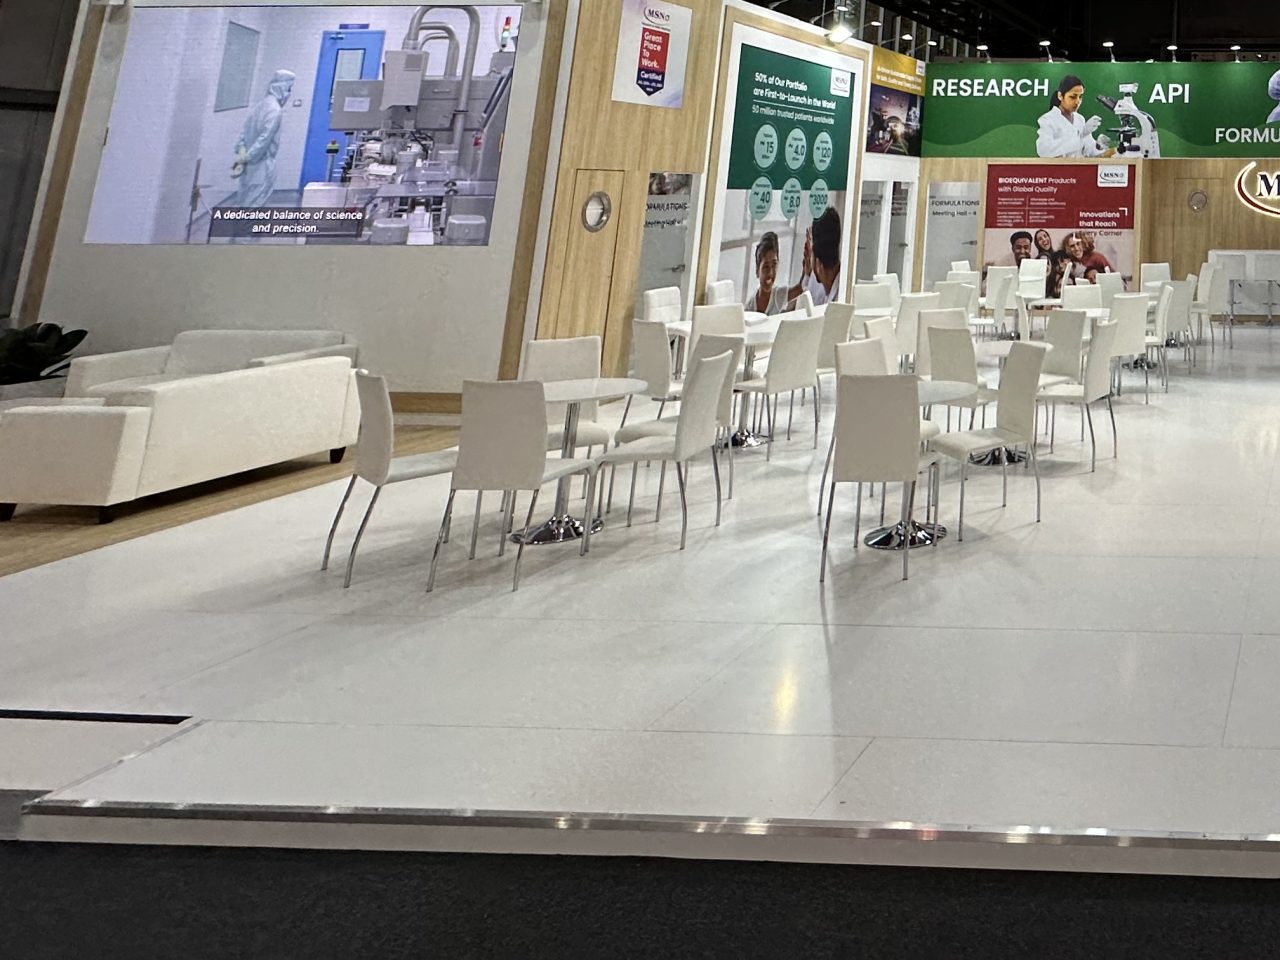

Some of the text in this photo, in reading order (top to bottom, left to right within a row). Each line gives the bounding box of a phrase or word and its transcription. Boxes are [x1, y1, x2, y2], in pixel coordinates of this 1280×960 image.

[648, 8, 666, 20] MSN
[644, 32, 663, 43] Great
[643, 41, 662, 52] Place
[642, 49, 650, 57] To
[775, 76, 786, 87] Our
[753, 87, 764, 97] are
[931, 78, 1050, 98] RESEARCH
[1148, 83, 1190, 105] API
[1034, 186, 1058, 194] Quality
[214, 210, 363, 221] A dedicated balance of science
[1079, 219, 1094, 227] that
[252, 224, 320, 236] and precision.
